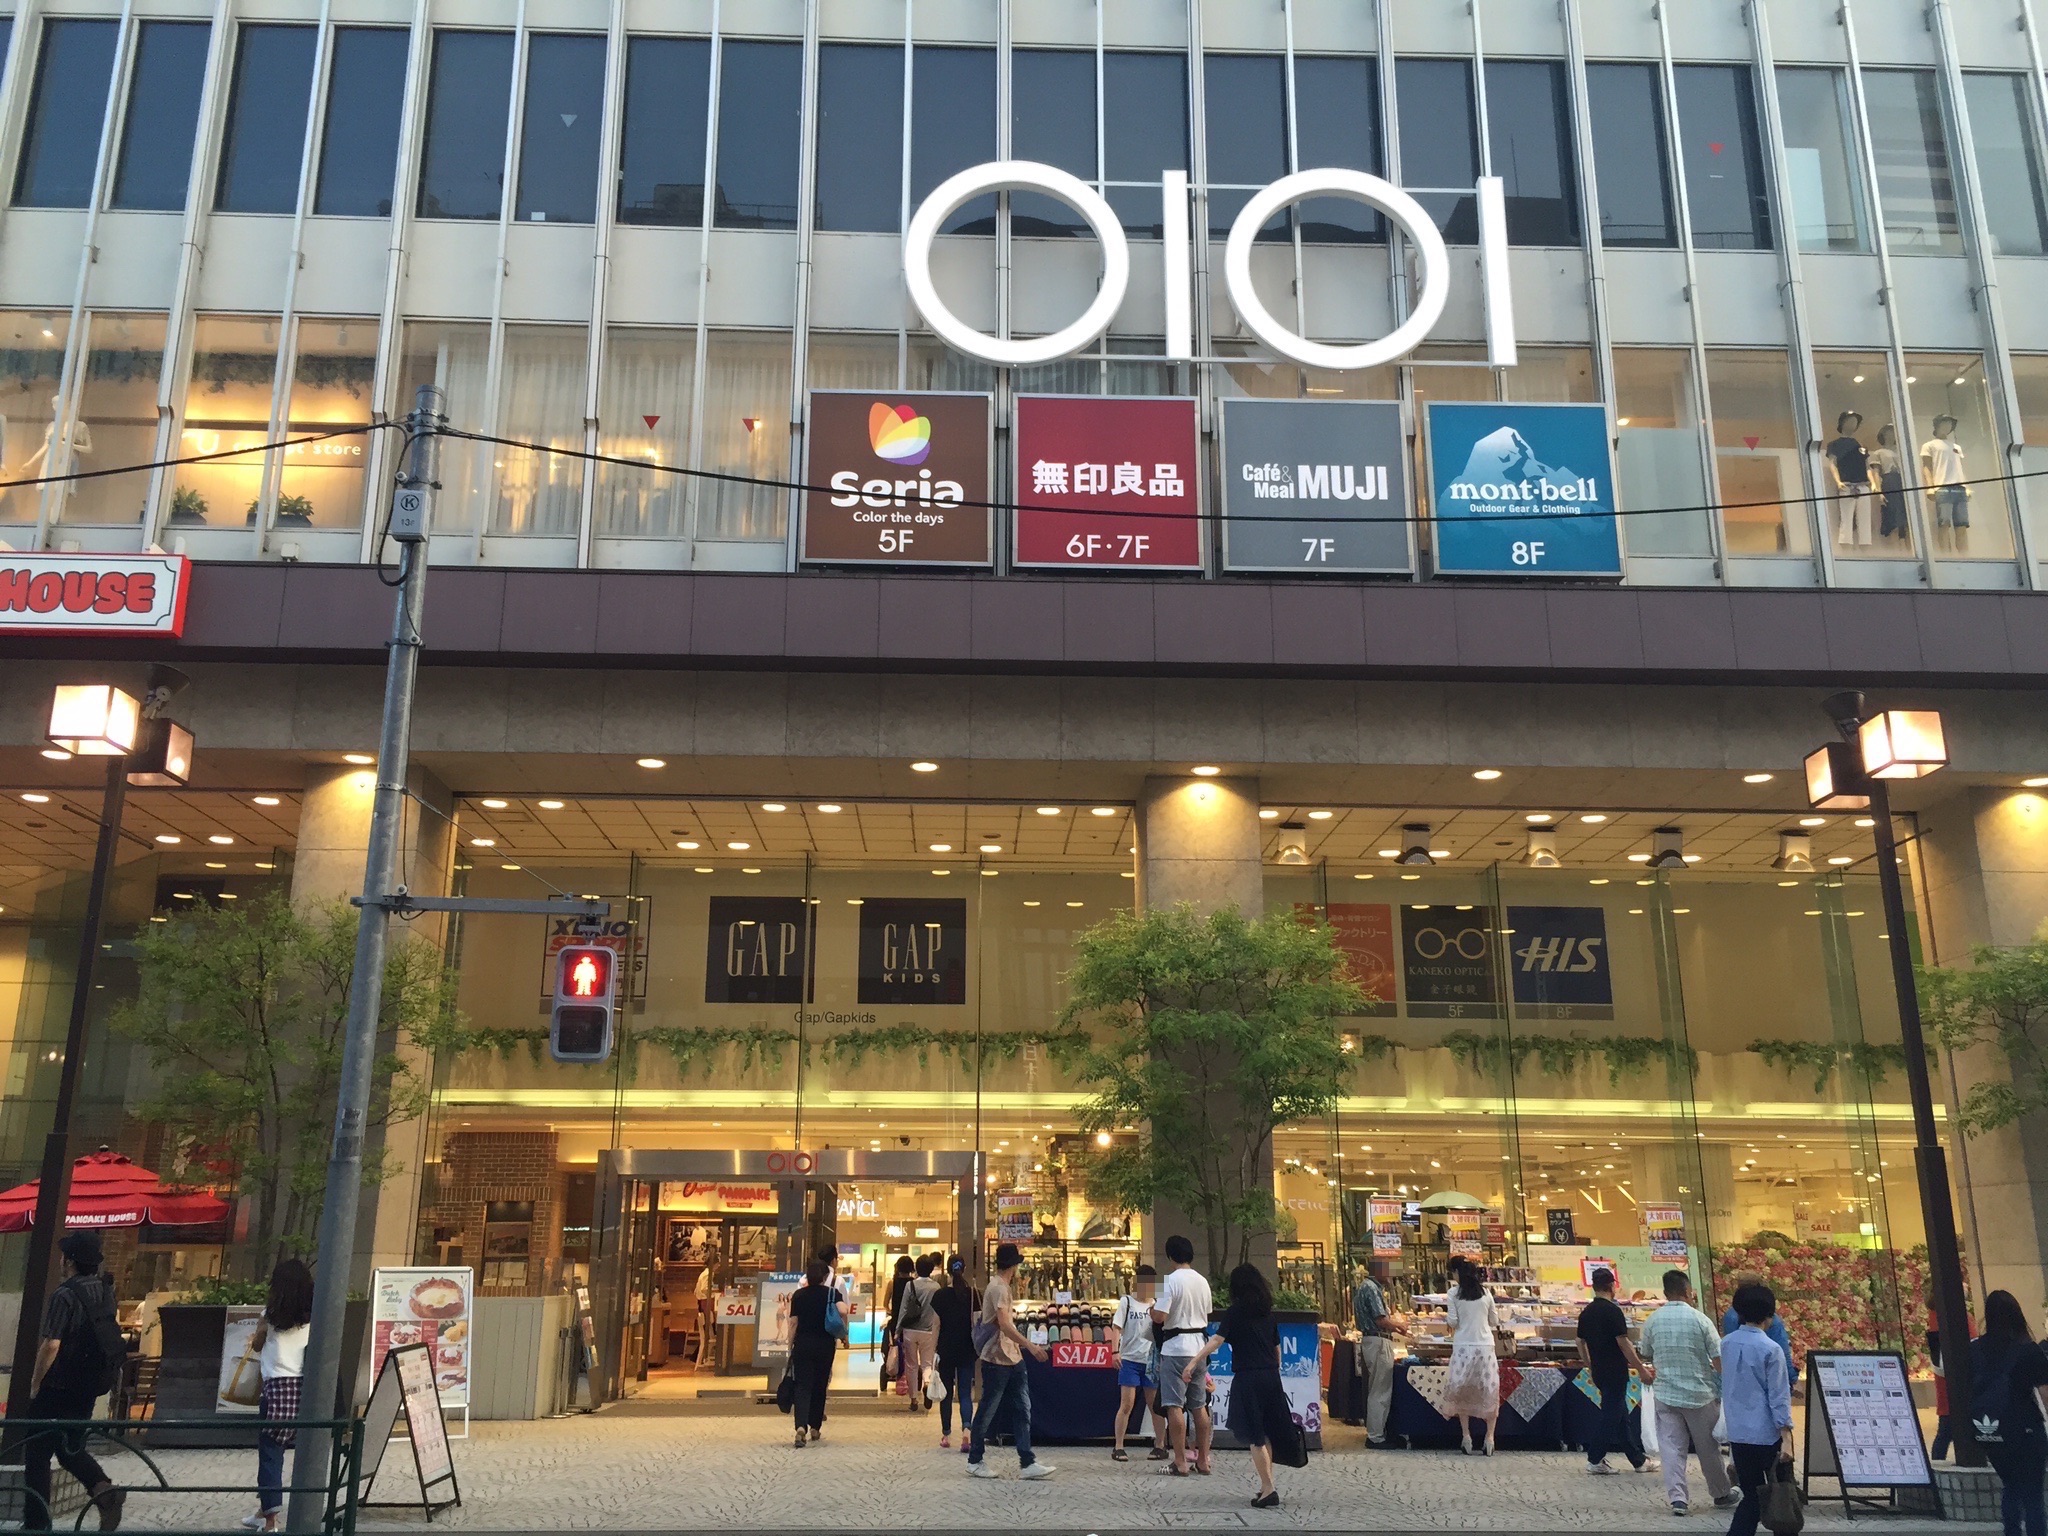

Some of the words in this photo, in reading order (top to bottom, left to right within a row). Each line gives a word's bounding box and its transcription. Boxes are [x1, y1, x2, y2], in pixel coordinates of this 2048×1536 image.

[313, 443, 362, 456] store
[1032, 459, 1184, 497] 無印良品
[1254, 482, 1294, 499] Meal
[1297, 464, 1389, 501] MUJI
[830, 469, 964, 508] Seria
[853, 511, 887, 523] Color
[891, 512, 912, 523] the
[915, 512, 944, 526] days
[1470, 503, 1506, 513] Outdoor
[1509, 504, 1530, 513] Gear
[1532, 505, 1540, 513] &
[1542, 505, 1581, 515] Clothing
[878, 529, 914, 553] 5F
[1302, 538, 1335, 562] 7F
[1511, 541, 1546, 565] 8F
[0, 568, 156, 614] HOUSE
[727, 921, 797, 977] GAP
[883, 923, 943, 970] GAP
[883, 973, 942, 983] KIDS
[1408, 966, 1451, 976] KANEKO
[1448, 1005, 1464, 1018] 5F
[1556, 1006, 1573, 1019] 8F
[65, 1215, 105, 1224] PANCAKE
[108, 1212, 137, 1223] HOUSE
[1811, 1224, 1831, 1232] SALE
[1056, 1345, 1109, 1365] SALE
